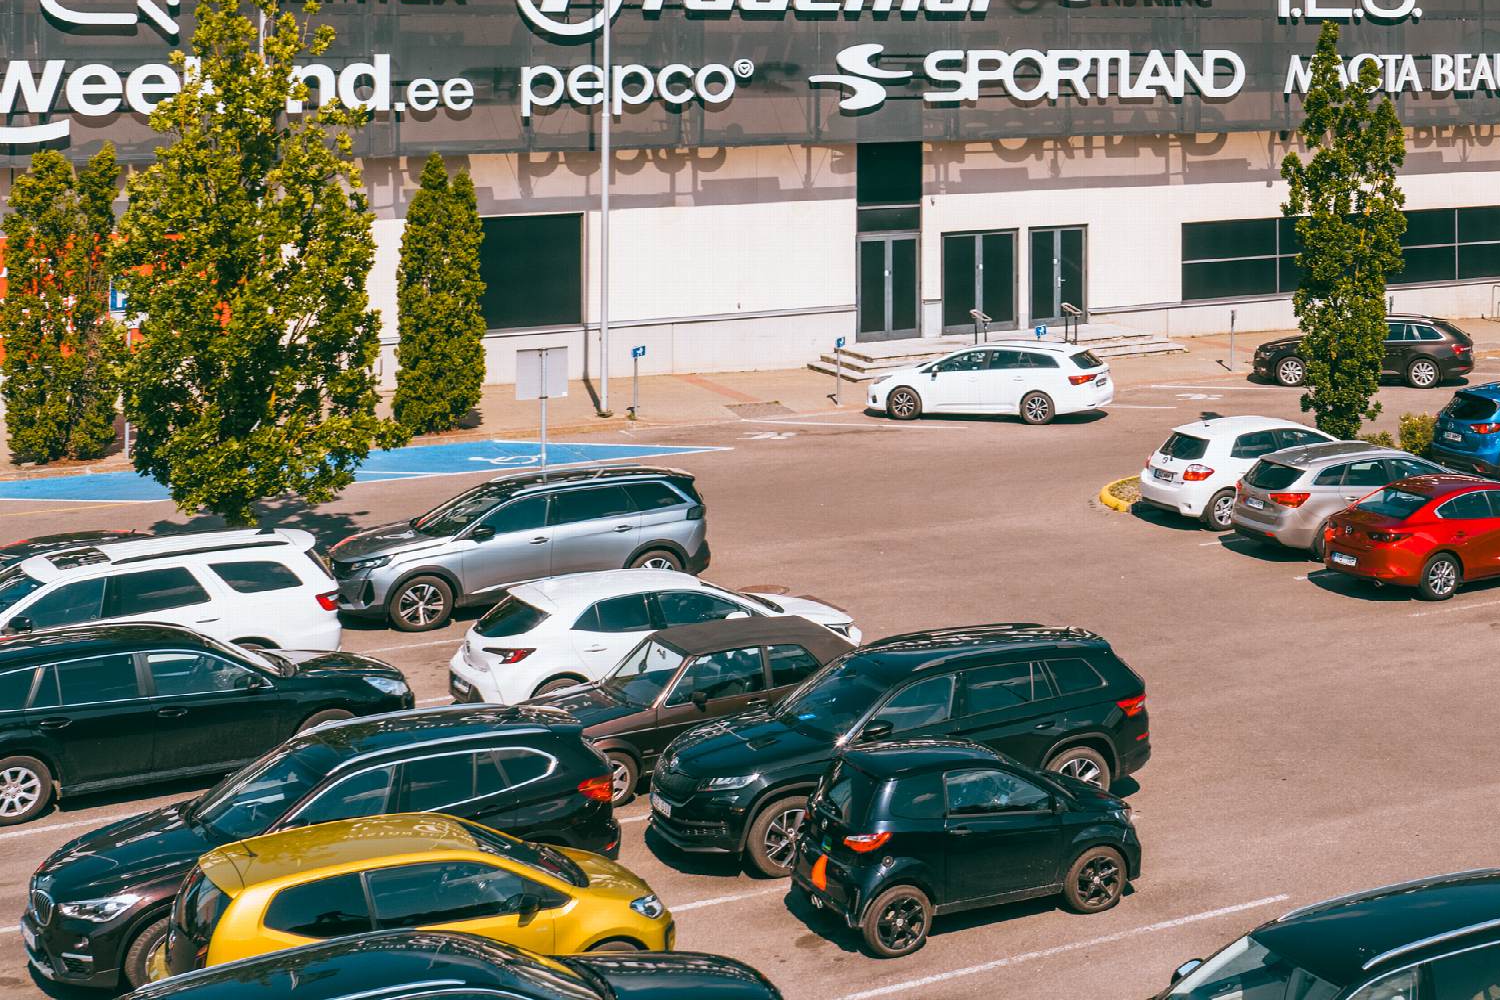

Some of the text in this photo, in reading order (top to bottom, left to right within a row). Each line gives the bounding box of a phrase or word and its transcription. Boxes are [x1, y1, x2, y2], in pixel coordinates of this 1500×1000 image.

[0, 53, 474, 117] weend.ee
[521, 62, 737, 118] pepco
[922, 48, 1247, 102] SPORTLAND
